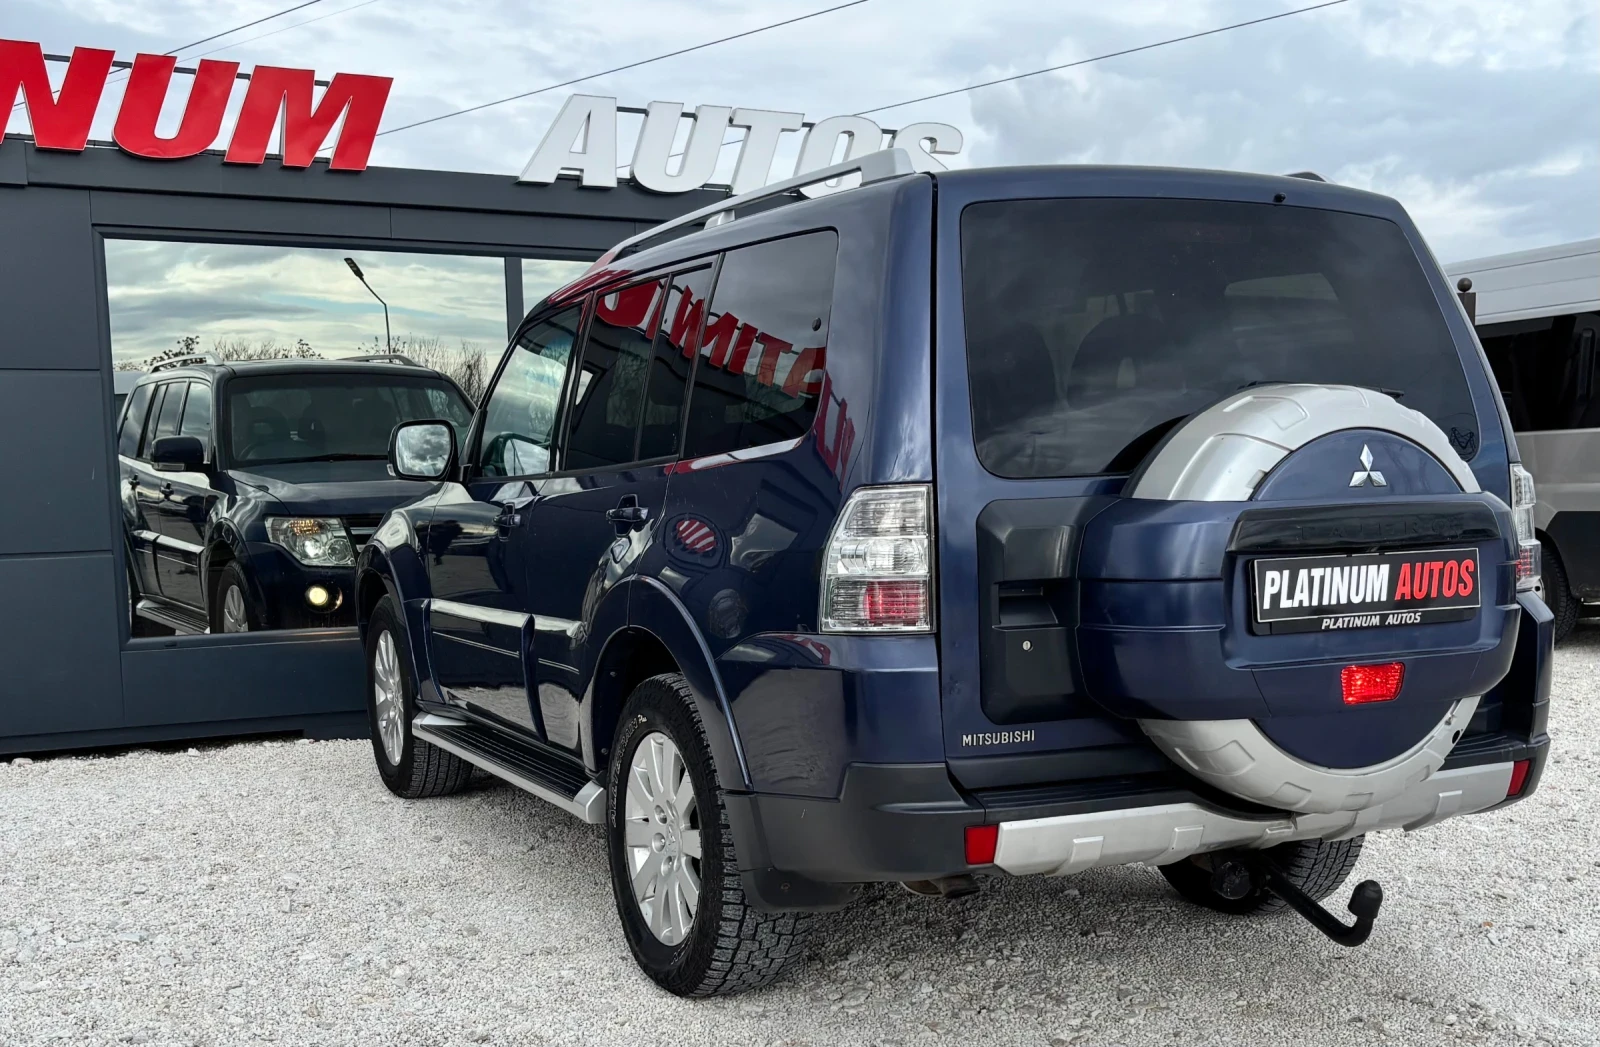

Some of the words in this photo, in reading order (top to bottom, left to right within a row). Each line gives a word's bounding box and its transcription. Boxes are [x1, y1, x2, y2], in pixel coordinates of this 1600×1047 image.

[0, 39, 393, 171] NUM
[1262, 563, 1391, 610] PLATINUM
[1394, 558, 1476, 601] AUTOS
[1321, 614, 1381, 630] PLATINUM
[1385, 611, 1422, 626] AUTOS
[962, 729, 1035, 747] MITSUBISHI
